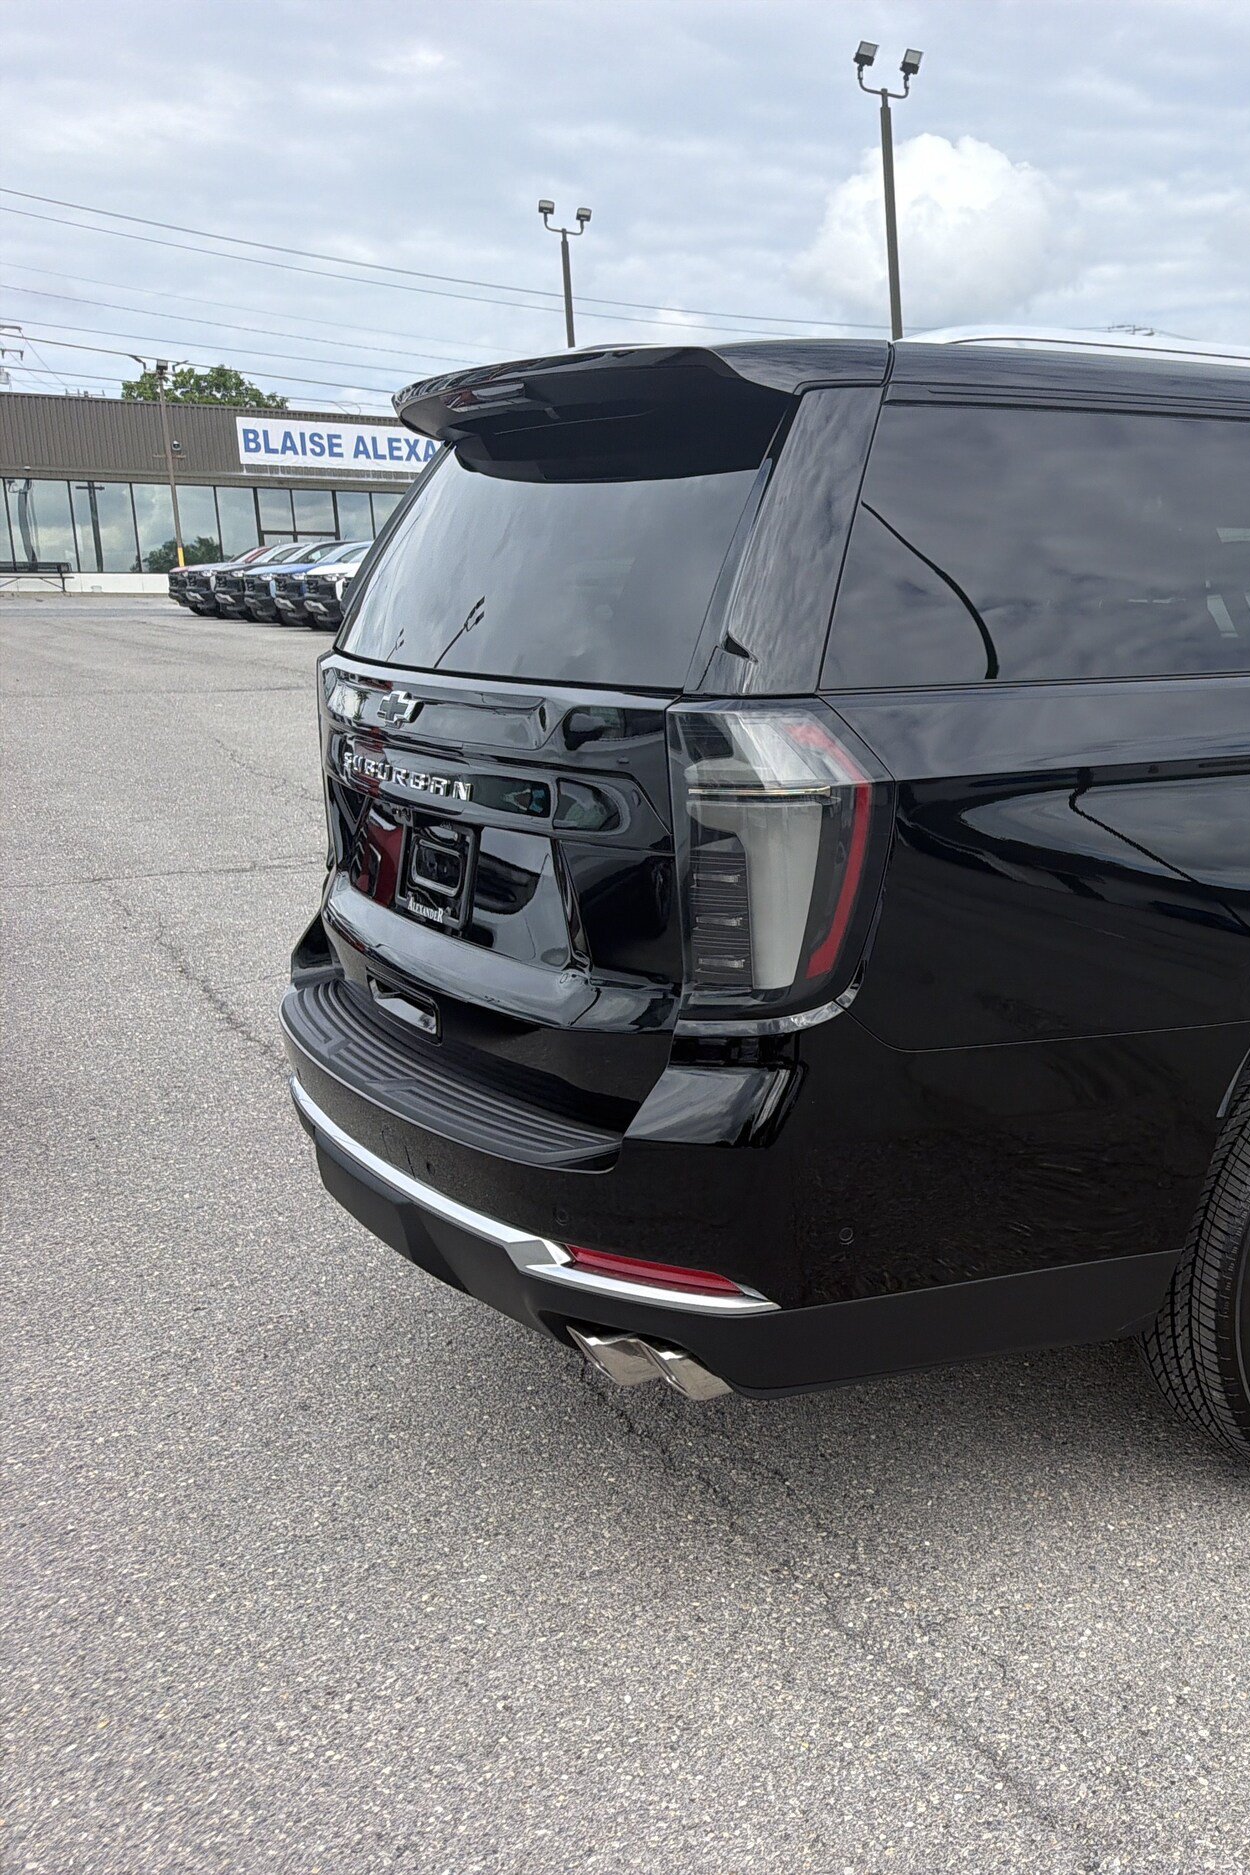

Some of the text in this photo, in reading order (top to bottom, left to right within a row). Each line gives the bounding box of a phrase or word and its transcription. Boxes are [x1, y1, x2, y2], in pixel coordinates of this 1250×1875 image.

[242, 428, 437, 462] BLAISE ALEXA
[343, 751, 473, 802] SUBURBAN
